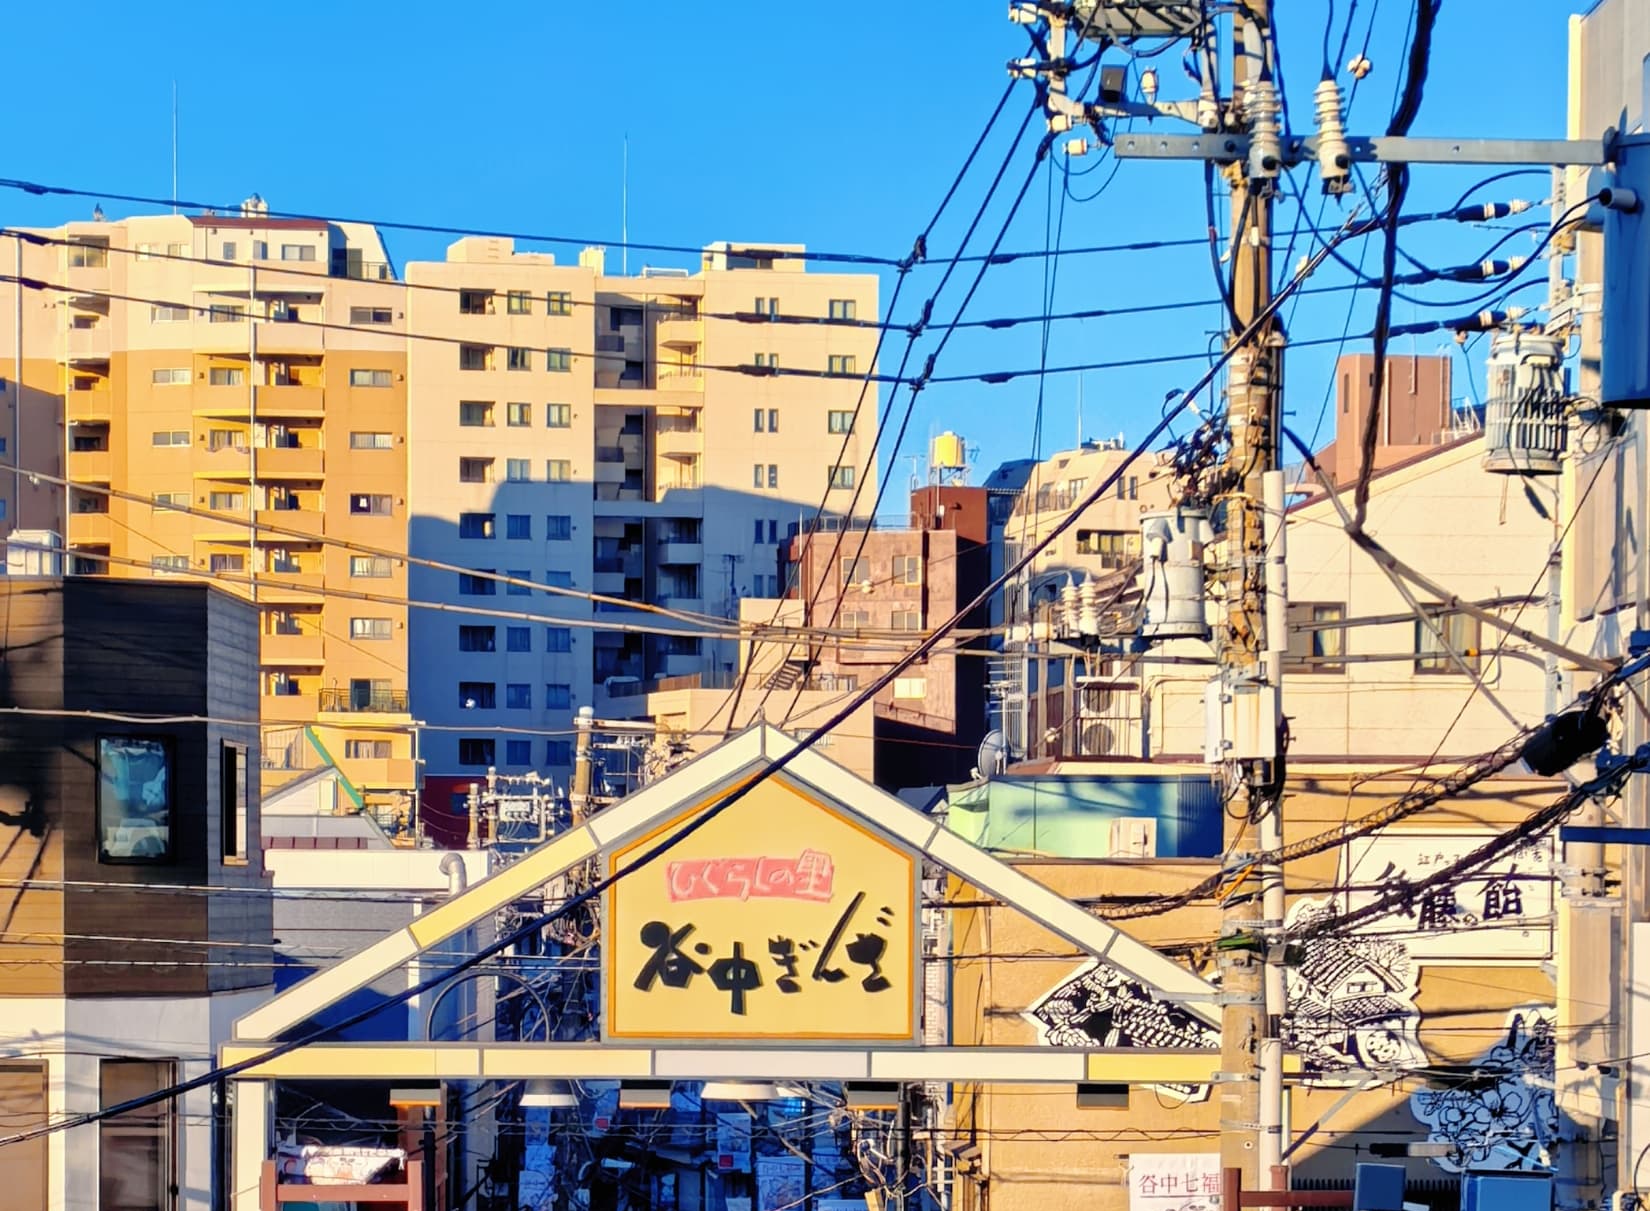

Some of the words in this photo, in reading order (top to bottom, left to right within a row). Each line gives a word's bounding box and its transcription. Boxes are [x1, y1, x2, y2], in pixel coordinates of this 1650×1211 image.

[634, 891, 895, 1017] 谷中ぎんざ
[1138, 1172, 1220, 1195] 谷中七福
